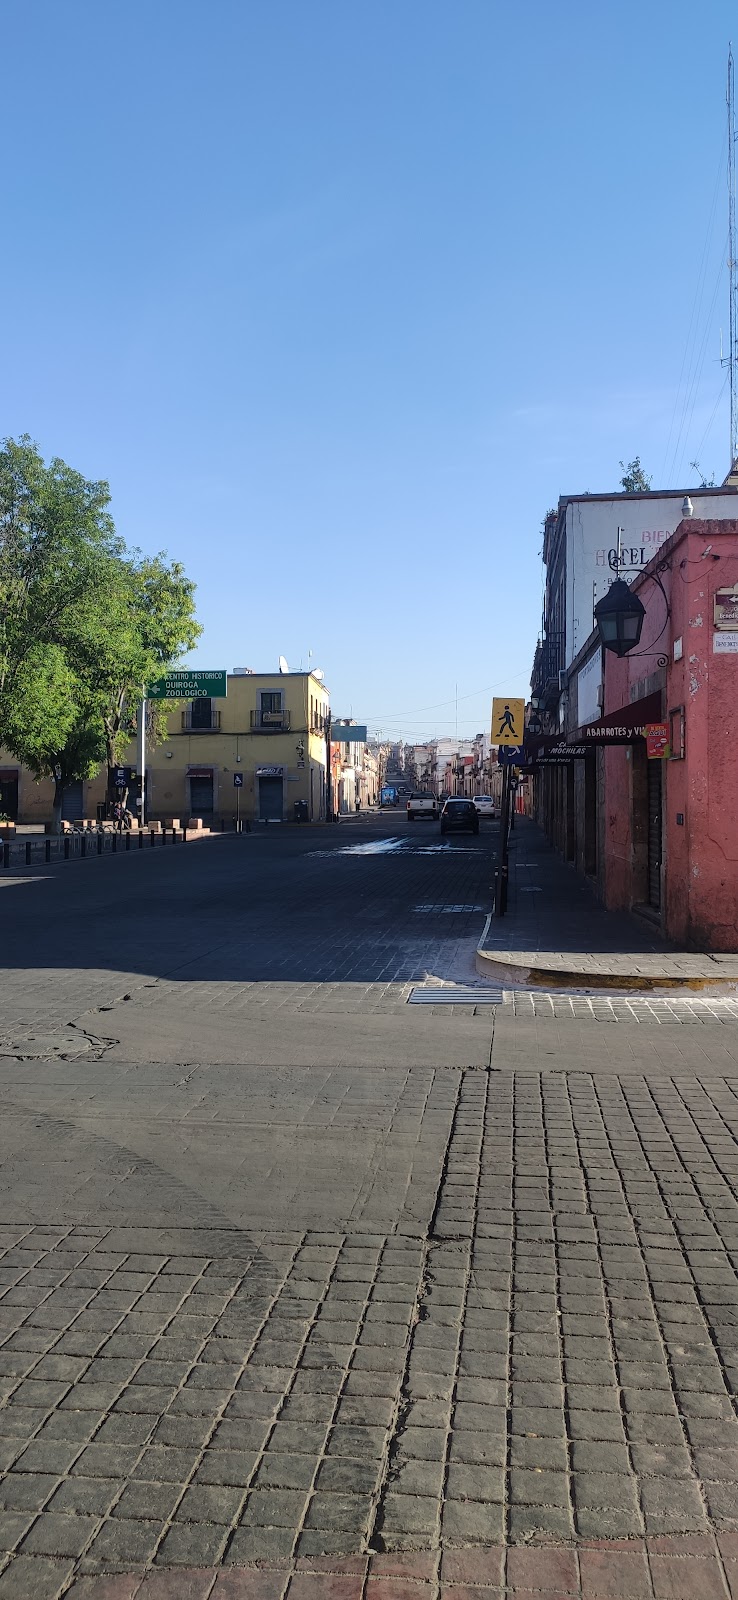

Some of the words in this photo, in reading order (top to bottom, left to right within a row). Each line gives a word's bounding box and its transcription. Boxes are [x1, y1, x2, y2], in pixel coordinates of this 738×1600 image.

[594, 547, 650, 566] HOTEL
[191, 672, 223, 680] HISTORICO
[165, 681, 199, 689] QUIROGA
[165, 689, 208, 697] ZOOLOGICO
[586, 726, 627, 737] ABARROTES
[626, 729, 633, 739] y
[633, 726, 646, 736] VI
[550, 747, 586, 755] MOCHILAS
[117, 769, 125, 777] E
